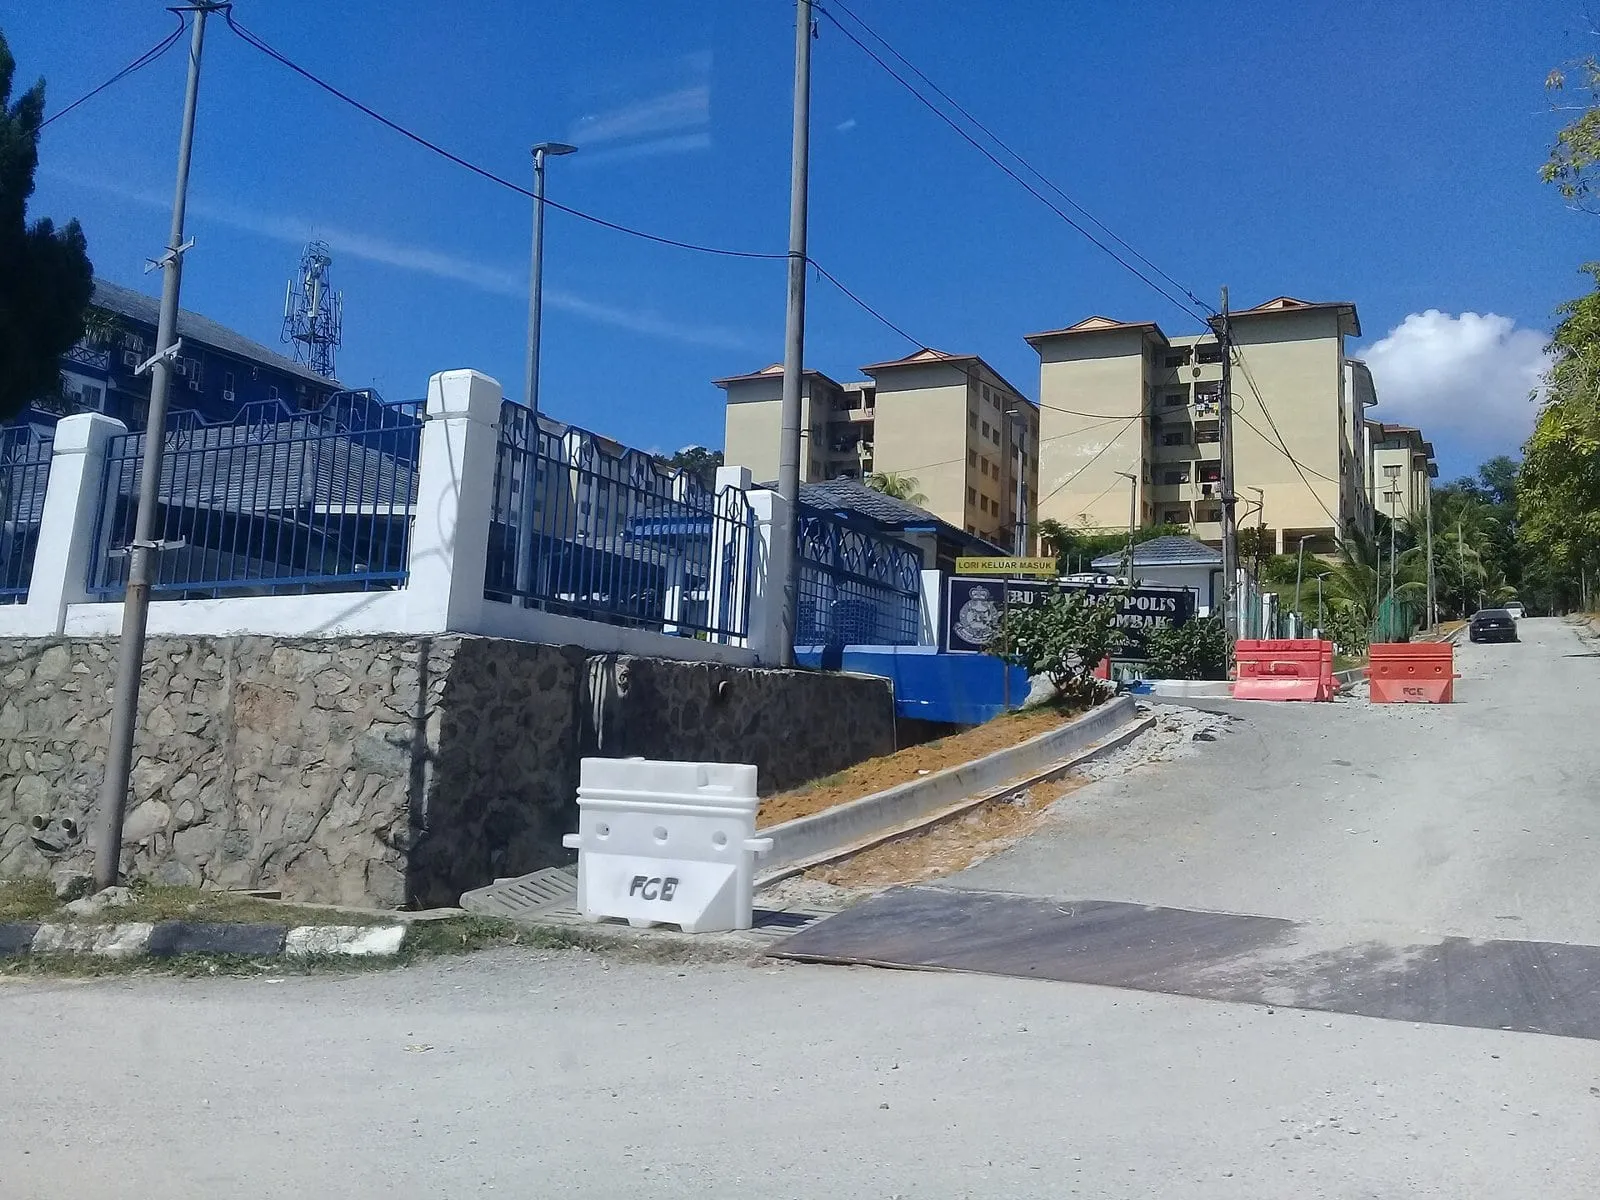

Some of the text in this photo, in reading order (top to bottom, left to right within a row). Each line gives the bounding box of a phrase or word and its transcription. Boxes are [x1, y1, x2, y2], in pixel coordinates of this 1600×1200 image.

[958, 561, 1052, 569] LORI KELUAR MASUK
[1123, 596, 1176, 611] POLIS
